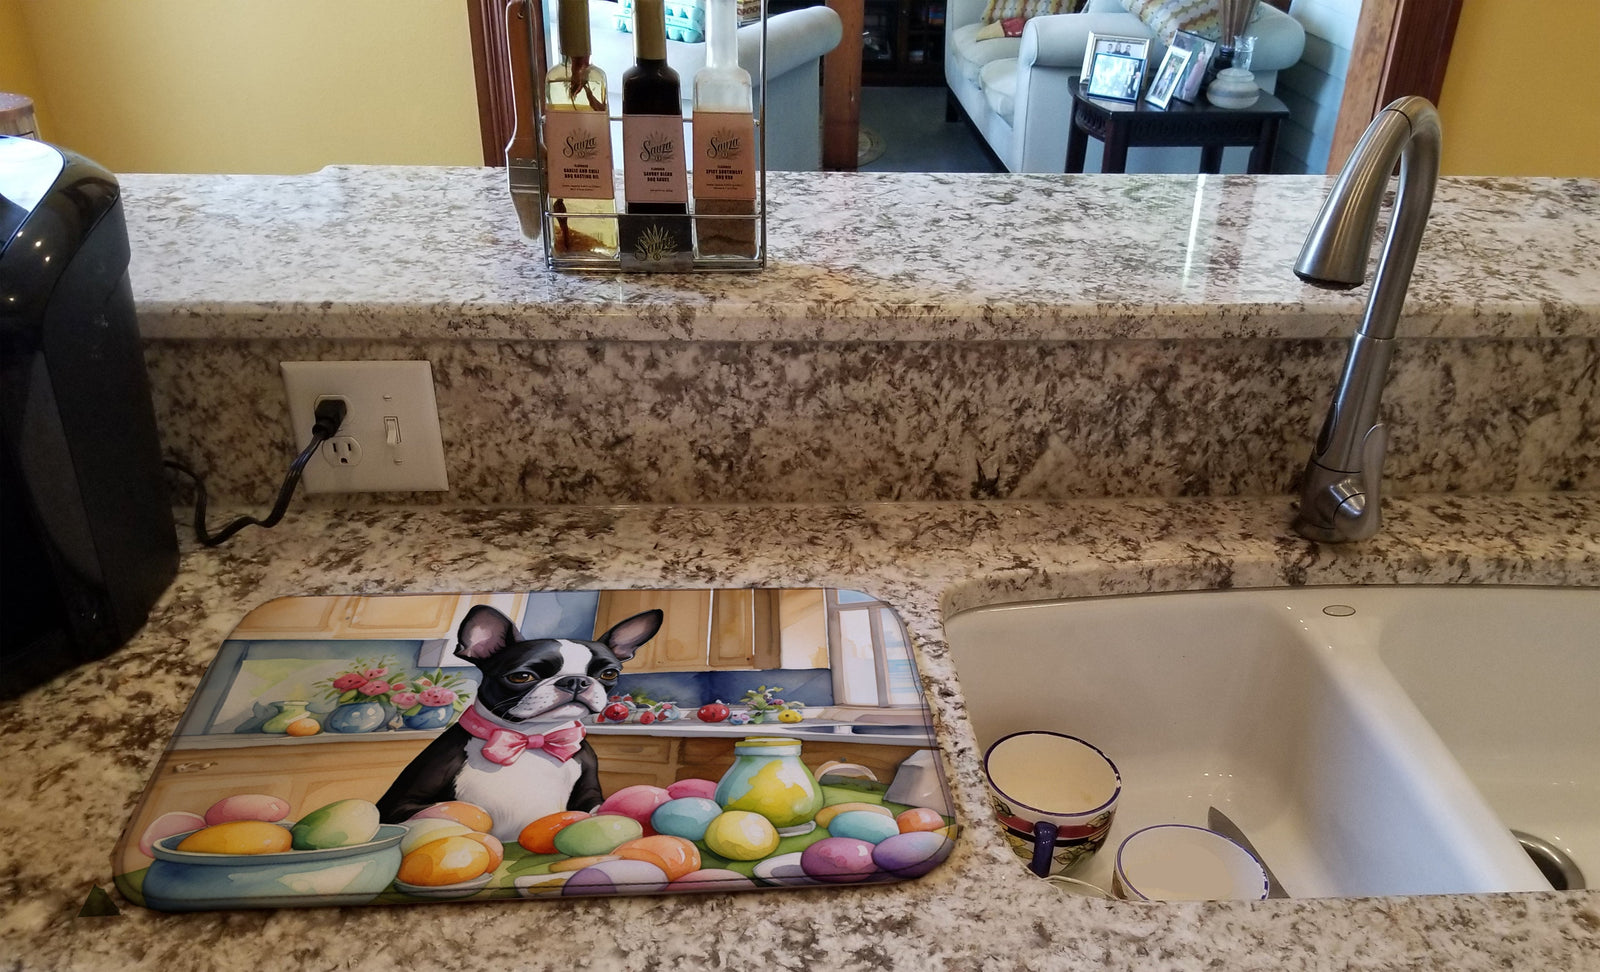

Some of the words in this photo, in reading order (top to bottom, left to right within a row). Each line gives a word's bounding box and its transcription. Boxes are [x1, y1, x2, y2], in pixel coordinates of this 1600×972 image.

[562, 136, 597, 158] Sauza
[640, 140, 674, 162] Sauza
[706, 136, 740, 159] Sauza
